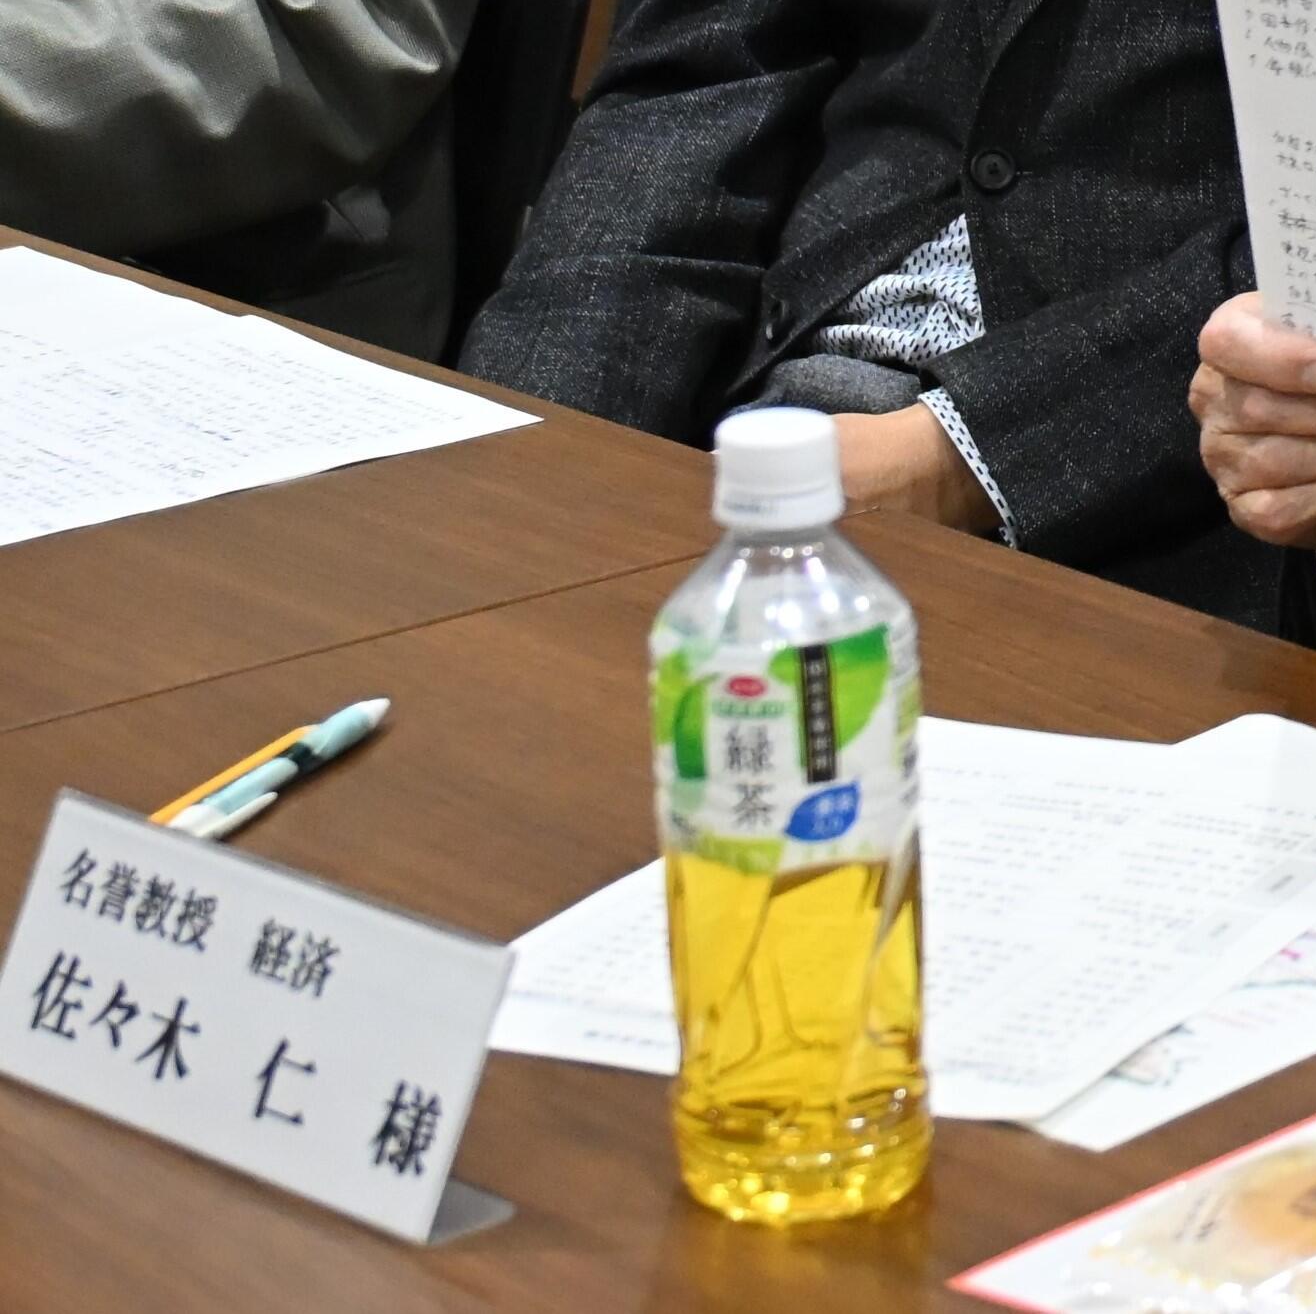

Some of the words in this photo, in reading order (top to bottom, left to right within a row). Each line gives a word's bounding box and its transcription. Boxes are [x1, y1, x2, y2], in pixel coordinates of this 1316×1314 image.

[59, 847, 219, 952] 名誉教授
[248, 917, 341, 1000] 経済
[29, 949, 202, 1082] 佐々木
[253, 1037, 317, 1127] 仁
[369, 1080, 444, 1177] 様
